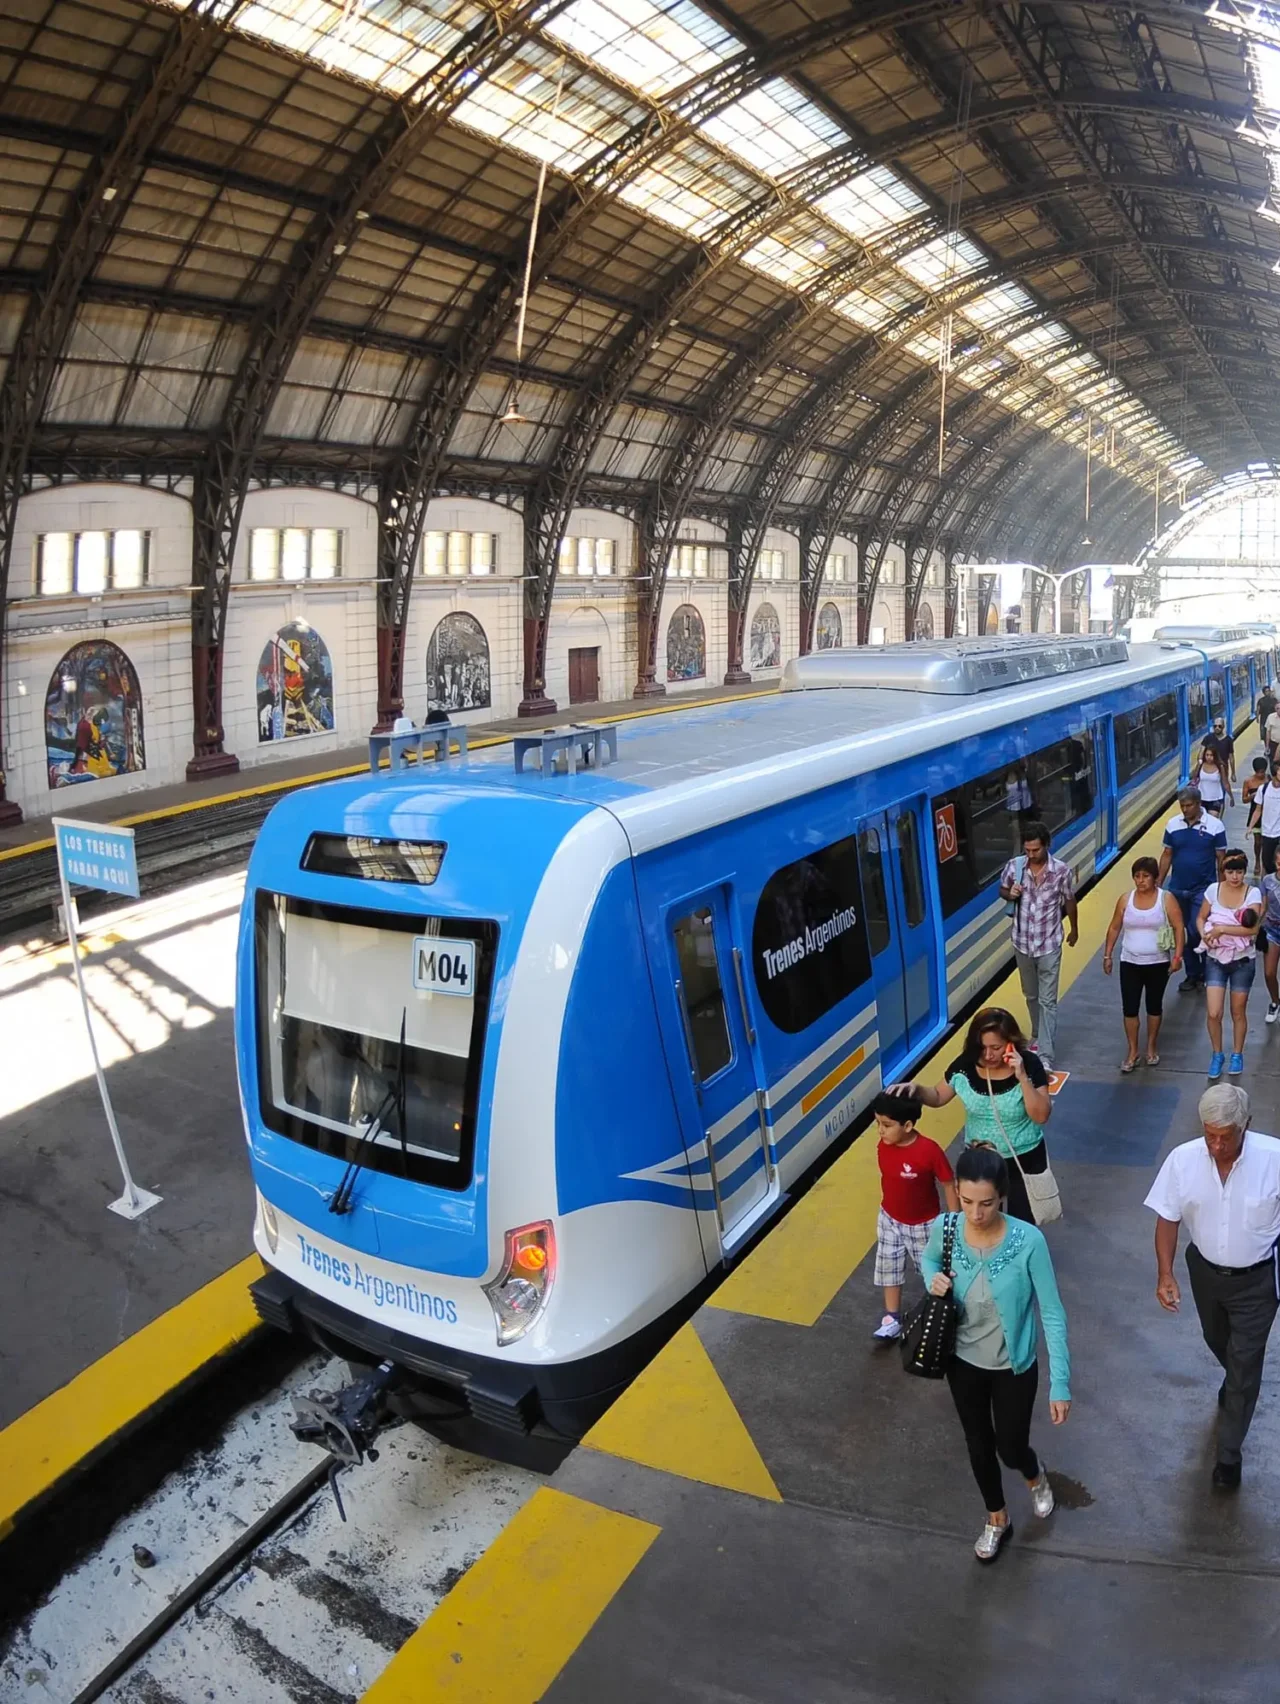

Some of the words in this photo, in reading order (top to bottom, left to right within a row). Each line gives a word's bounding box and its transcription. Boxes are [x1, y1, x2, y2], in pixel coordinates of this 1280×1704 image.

[64, 834, 82, 851] LOS
[86, 839, 126, 860] TRENES
[68, 859, 99, 880] PARAN
[103, 867, 129, 886] AQUI
[763, 949, 805, 980] Trenes
[805, 906, 856, 953] Argentinos
[418, 949, 468, 986] M04
[297, 1234, 351, 1286] Trenes
[355, 1262, 458, 1324] Argentinos
